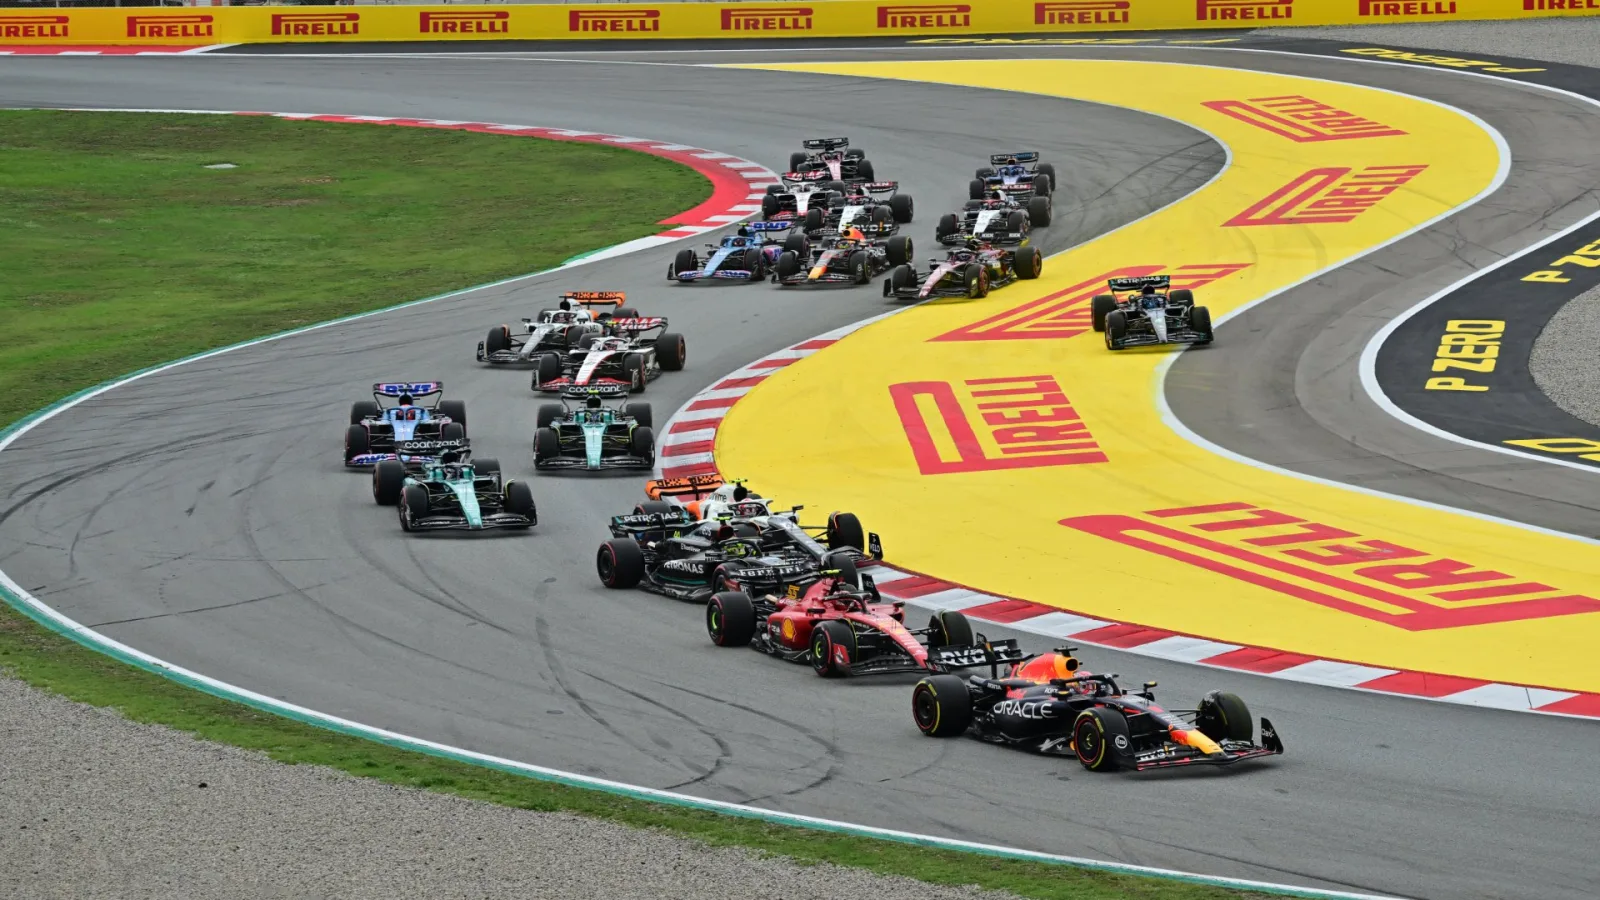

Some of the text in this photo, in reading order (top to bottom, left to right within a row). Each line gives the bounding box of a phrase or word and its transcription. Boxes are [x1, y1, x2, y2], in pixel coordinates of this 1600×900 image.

[1035, 1, 1130, 24] PIRELLI
[1196, 0, 1293, 20] PIRELLI
[1359, 0, 1456, 16] PIRELLI
[1523, 0, 1600, 10] IREL
[127, 15, 213, 37] PIRELLI
[271, 13, 360, 35] PIRELLI
[419, 11, 509, 33] PIRELLI
[569, 9, 660, 31] PIRELLI
[720, 8, 813, 30] PIRELLI
[877, 5, 971, 28] PIRELLI
[1200, 95, 1410, 142] PIRELLI
[1220, 165, 1430, 227] PIRELLI
[926, 263, 1255, 342] PILLI
[1425, 320, 1506, 391] P ZERO
[890, 375, 1109, 475] PIRELLI
[663, 560, 704, 574] PETRONAS
[1058, 502, 1600, 631] PIRELLI
[787, 585, 800, 600] 55
[993, 700, 1058, 719] ORACLE
